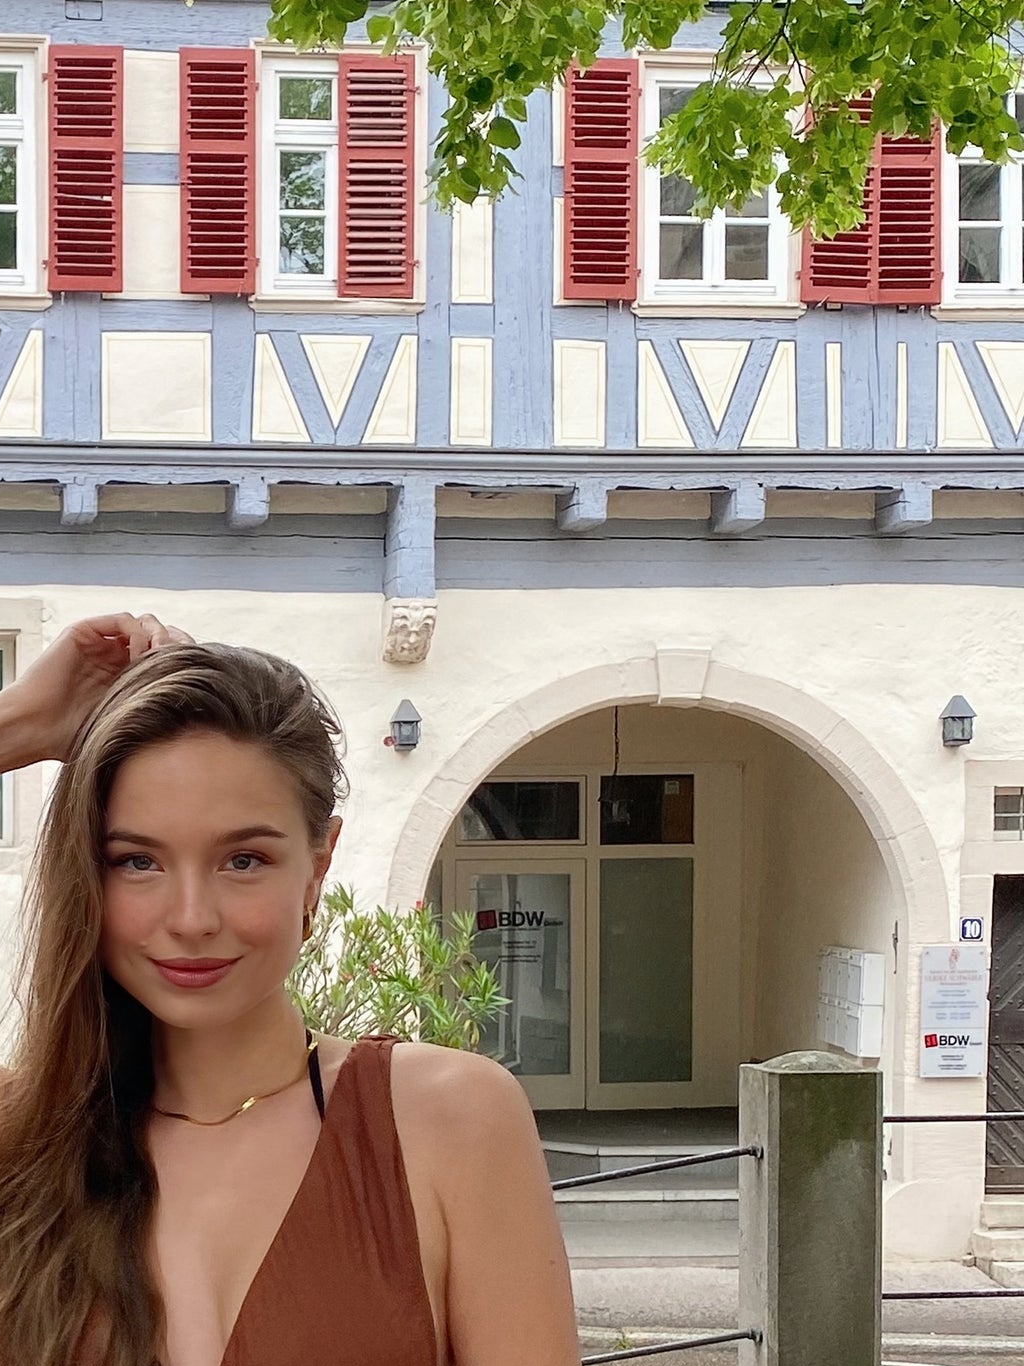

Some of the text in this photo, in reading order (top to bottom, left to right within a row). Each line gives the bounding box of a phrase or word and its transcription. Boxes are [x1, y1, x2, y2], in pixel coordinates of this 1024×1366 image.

[498, 911, 545, 927] BDW
[964, 920, 981, 938] 10
[939, 1035, 970, 1046] BDW
